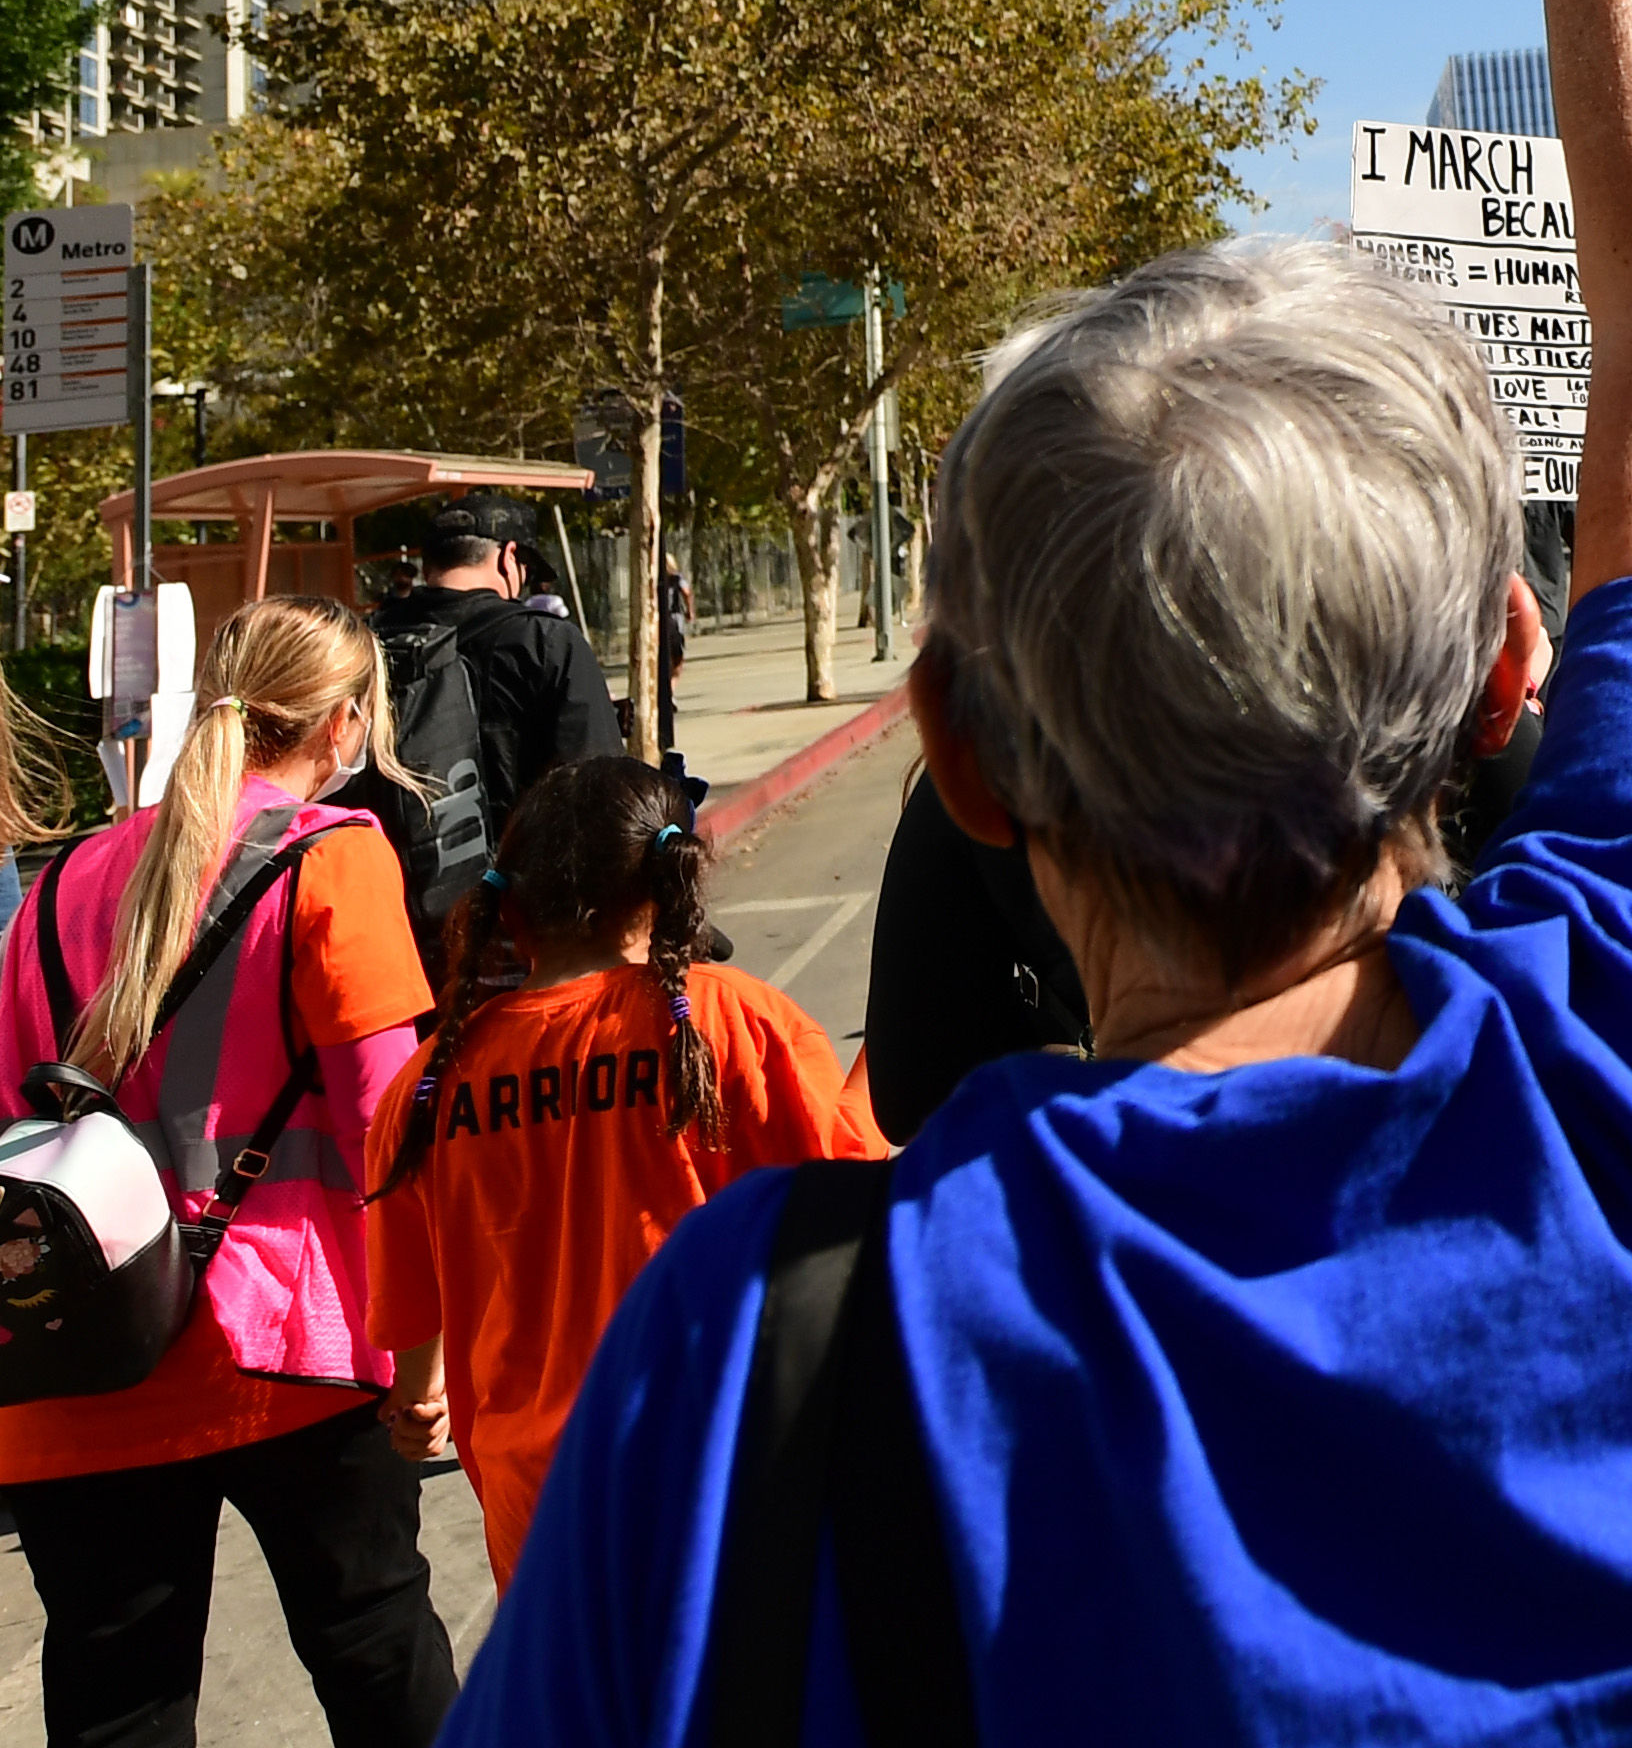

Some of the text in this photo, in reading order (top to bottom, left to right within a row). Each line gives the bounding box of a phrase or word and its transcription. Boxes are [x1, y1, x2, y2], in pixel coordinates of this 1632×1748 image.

[1361, 126, 1533, 196] I MARCH
[20, 223, 48, 249] M
[61, 241, 126, 260] Metro
[10, 279, 25, 299] 2
[12, 304, 27, 322] 4
[10, 329, 36, 349] 10
[10, 354, 41, 374] 48
[10, 378, 38, 400] 81
[1493, 377, 1548, 401] LOVE
[434, 1048, 660, 1142] ARRIOR
